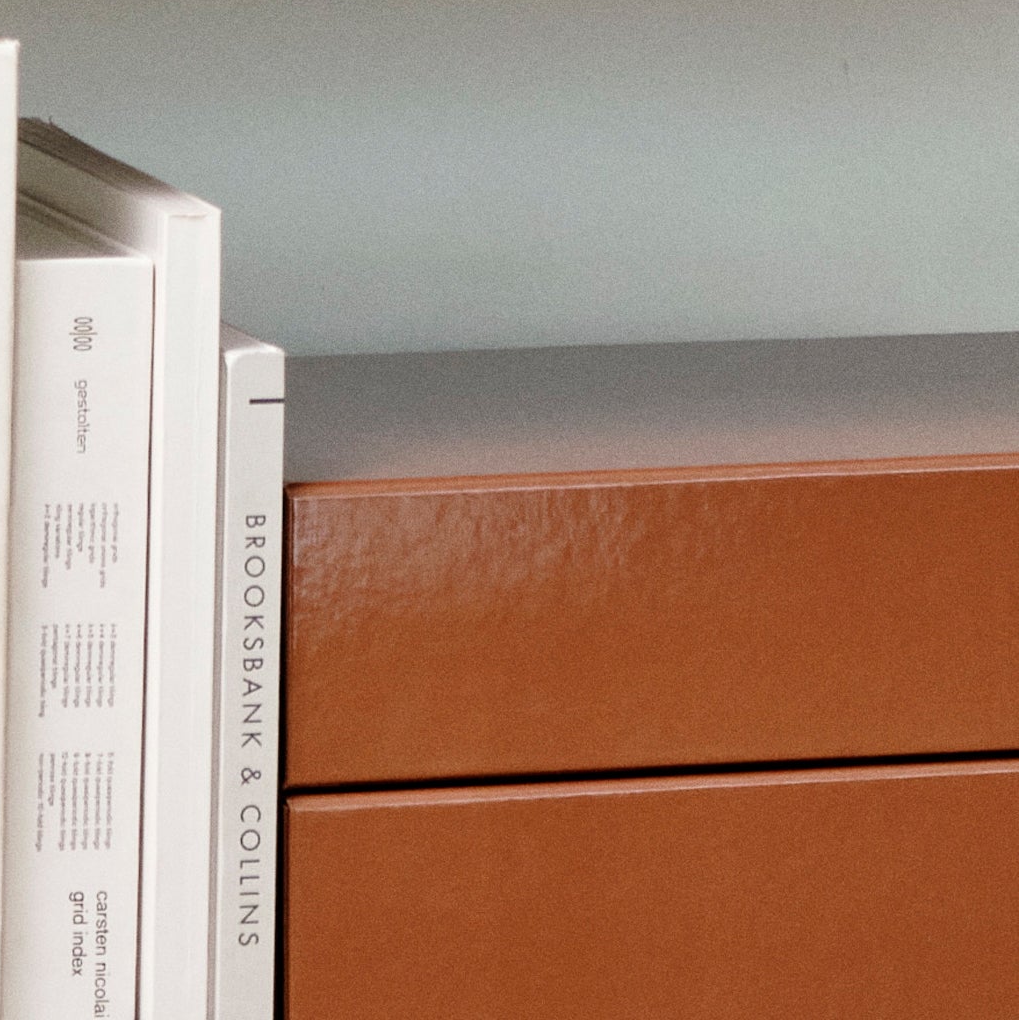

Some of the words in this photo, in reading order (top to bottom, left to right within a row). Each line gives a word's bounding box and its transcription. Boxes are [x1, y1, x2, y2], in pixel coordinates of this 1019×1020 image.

[74, 380, 90, 453] gestalten
[241, 515, 266, 748] BROOKSBANK
[241, 767, 261, 785] &
[238, 804, 261, 946] COLLINS
[69, 891, 88, 925] grid
[96, 891, 108, 955] carsten
[72, 932, 87, 976] index
[94, 962, 109, 1017] nicolai
